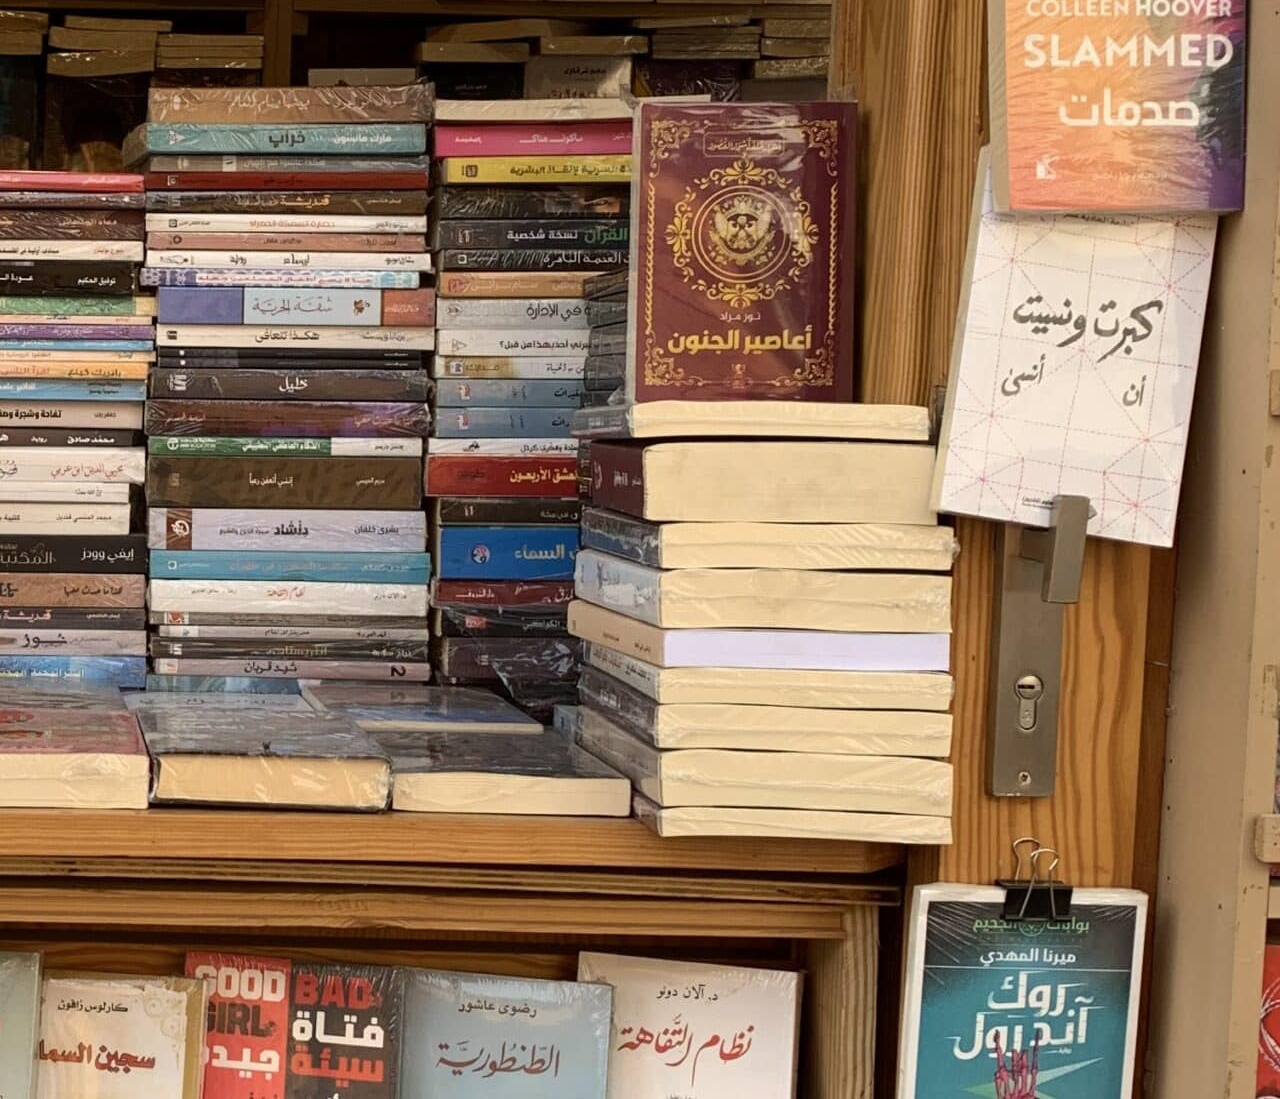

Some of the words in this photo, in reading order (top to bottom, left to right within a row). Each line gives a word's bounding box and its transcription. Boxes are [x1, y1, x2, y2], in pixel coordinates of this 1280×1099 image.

[1023, 33, 1234, 69] SLAMMED
[1058, 87, 1201, 127] صدمات
[268, 130, 306, 148] خراب
[1012, 295, 1088, 349] ونسيت
[1094, 300, 1165, 364] كبرت
[667, 328, 740, 356] الجنون
[742, 325, 813, 356] أعاصير
[979, 947, 1039, 968] المهدي
[1042, 947, 1077, 964] ميرنا
[295, 973, 374, 1010] BAD
[457, 999, 496, 1015] عاشور
[291, 1011, 385, 1049] فتاة
[95, 1046, 156, 1071] سجين
